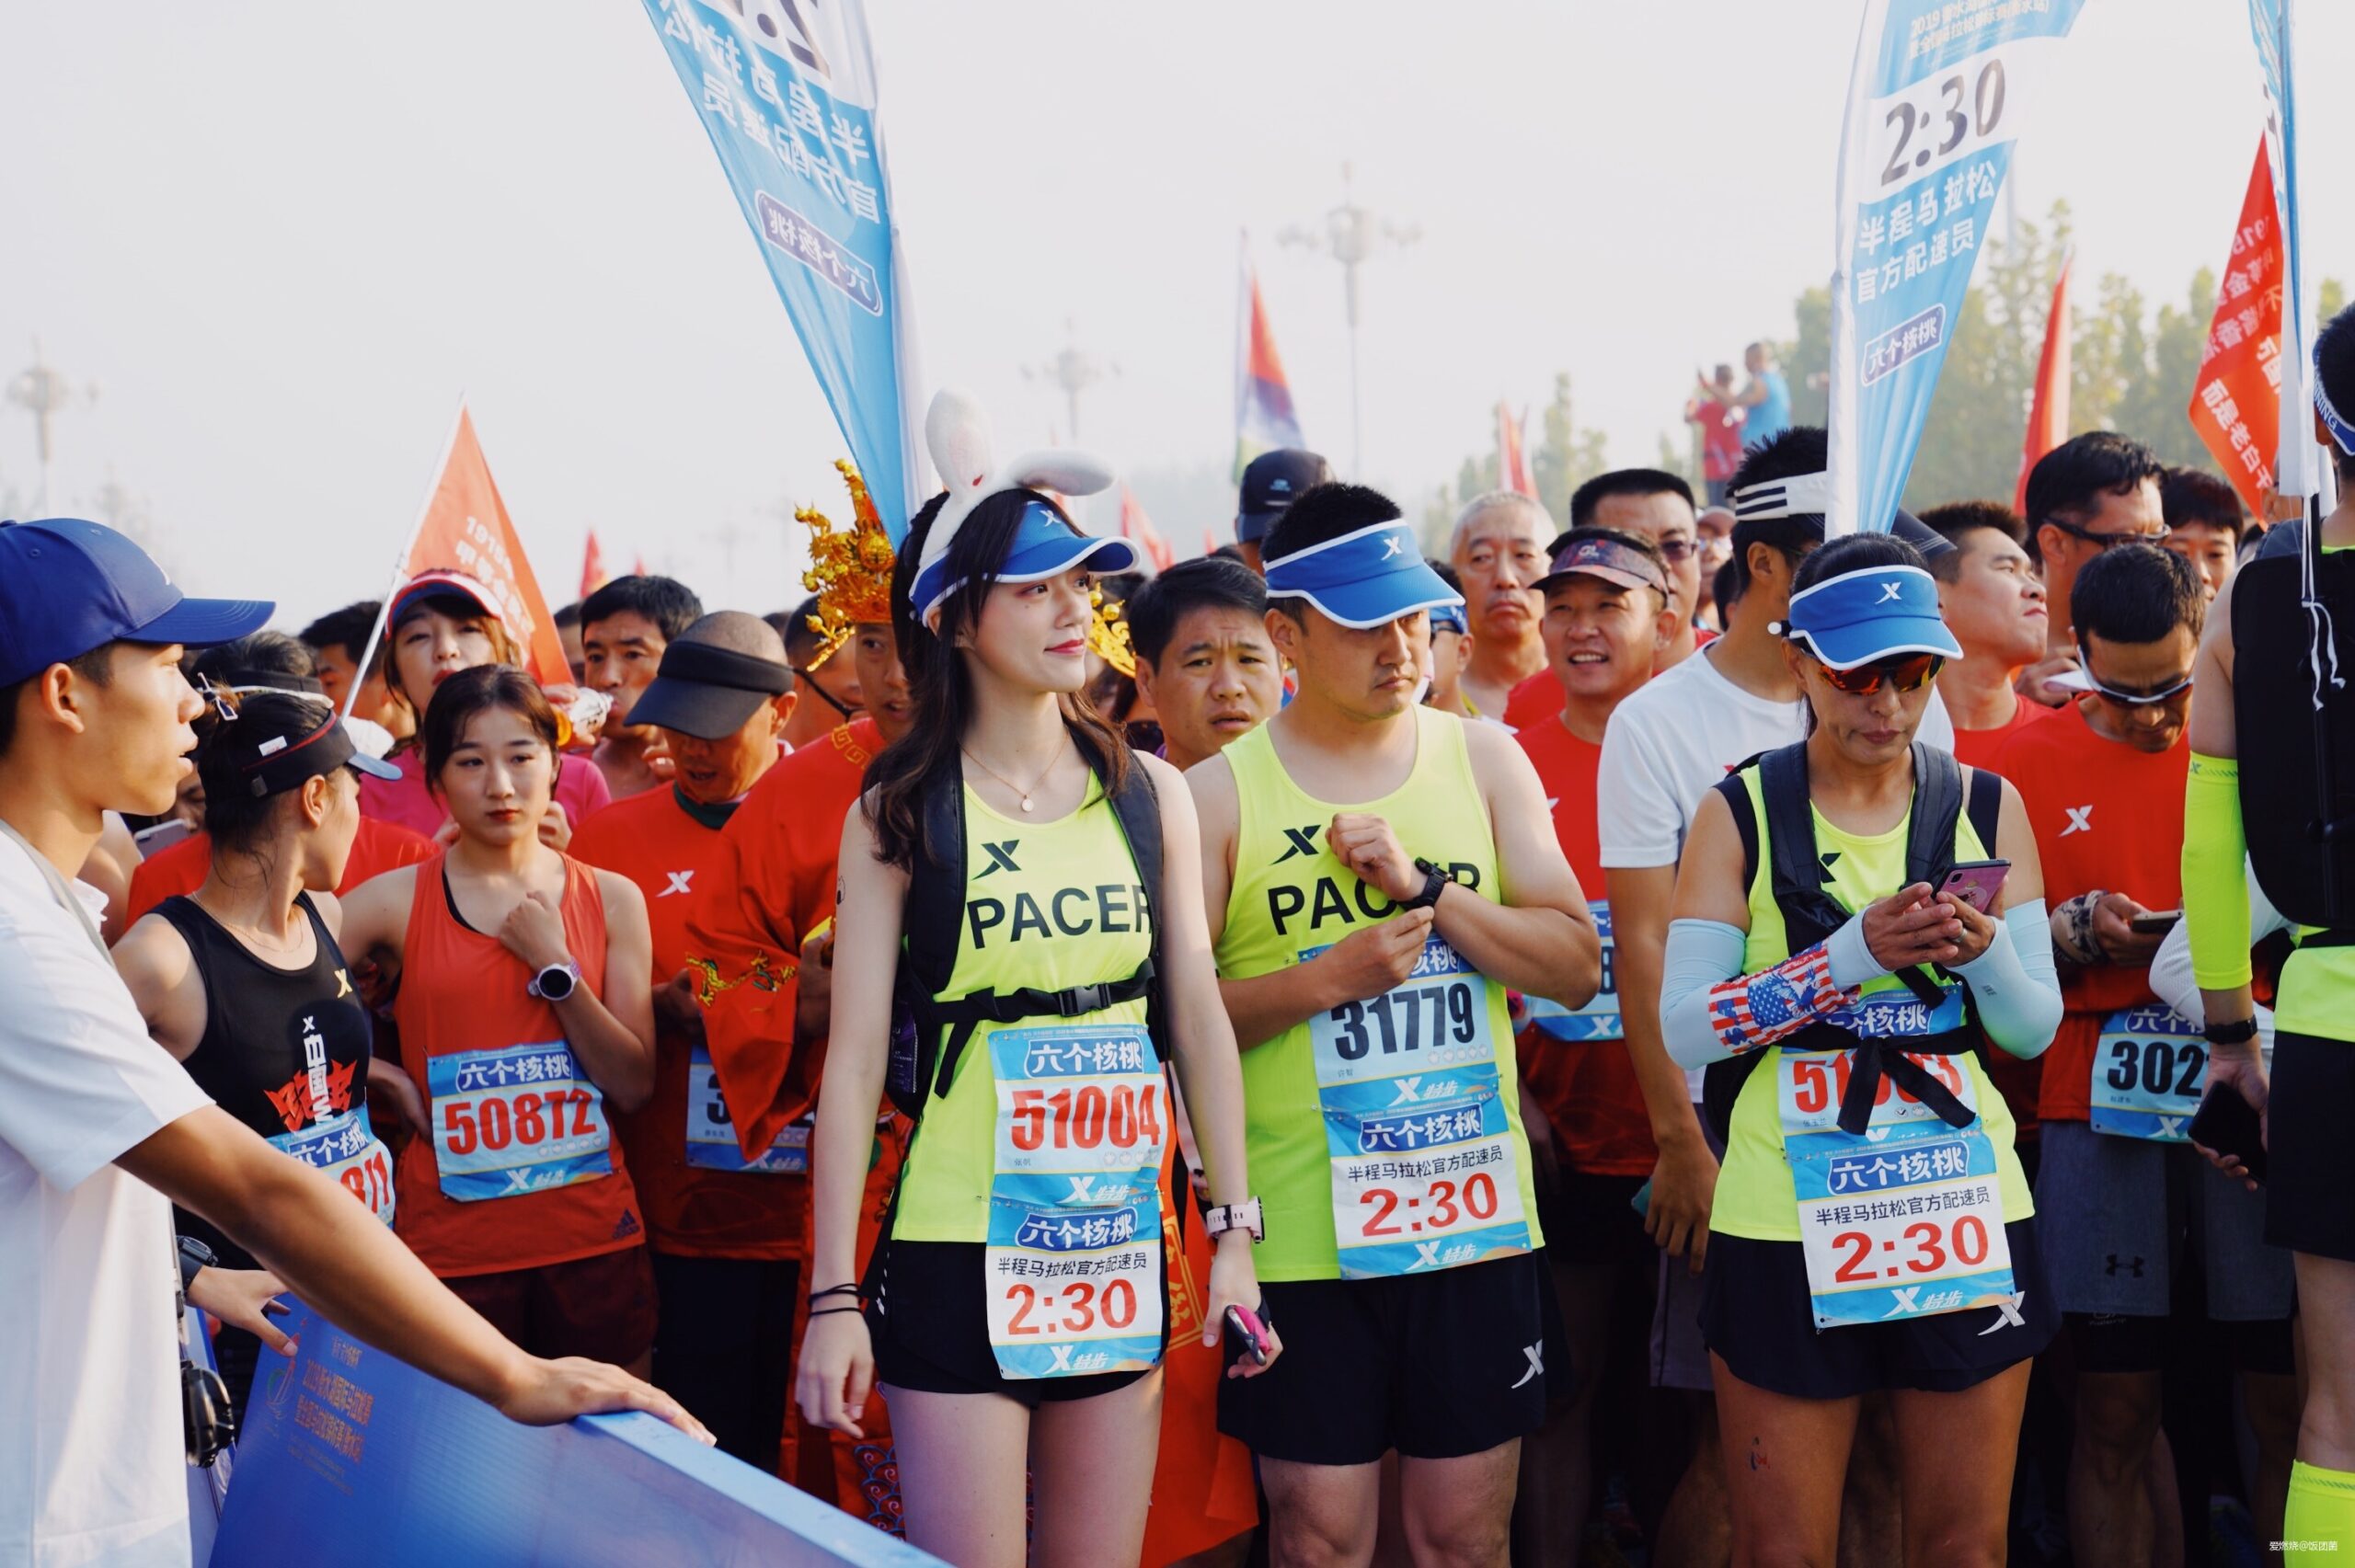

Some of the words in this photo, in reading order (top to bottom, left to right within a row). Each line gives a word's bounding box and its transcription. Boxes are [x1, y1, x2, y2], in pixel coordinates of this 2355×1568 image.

[1881, 59, 2005, 186] 2:30
[1859, 160, 1996, 256] 半程马拉松
[1856, 218, 1974, 304] 官方配速员
[1868, 316, 1936, 375] 六个核桃
[2200, 378, 2273, 489] 而是老白干
[1268, 863, 1481, 936] PACR
[1331, 982, 1476, 1060] 31779
[2131, 1008, 2207, 1034] 六个
[460, 1054, 569, 1090] 六个核桃
[1030, 1041, 1143, 1074] 六个核桃
[1793, 1052, 1963, 1113] 513
[2107, 1040, 2210, 1098] 302
[444, 1088, 597, 1155] 50872
[1011, 1083, 1161, 1151] 51004
[1363, 1108, 1481, 1150] 六个核桃
[1347, 1145, 1503, 1184] 半程马拉松官方配速员
[1832, 1146, 1966, 1191] 六个核桃
[1022, 1212, 1135, 1249] 六个核桃
[1360, 1173, 1499, 1237] 2:30
[1815, 1186, 1991, 1226] 半程马拉松官方配速员
[997, 1252, 1148, 1278] 半程马拉松官方配速员
[1831, 1215, 1990, 1284] 2:30
[1005, 1278, 1138, 1335] 2:30
[1922, 1290, 1964, 1311] 特步
